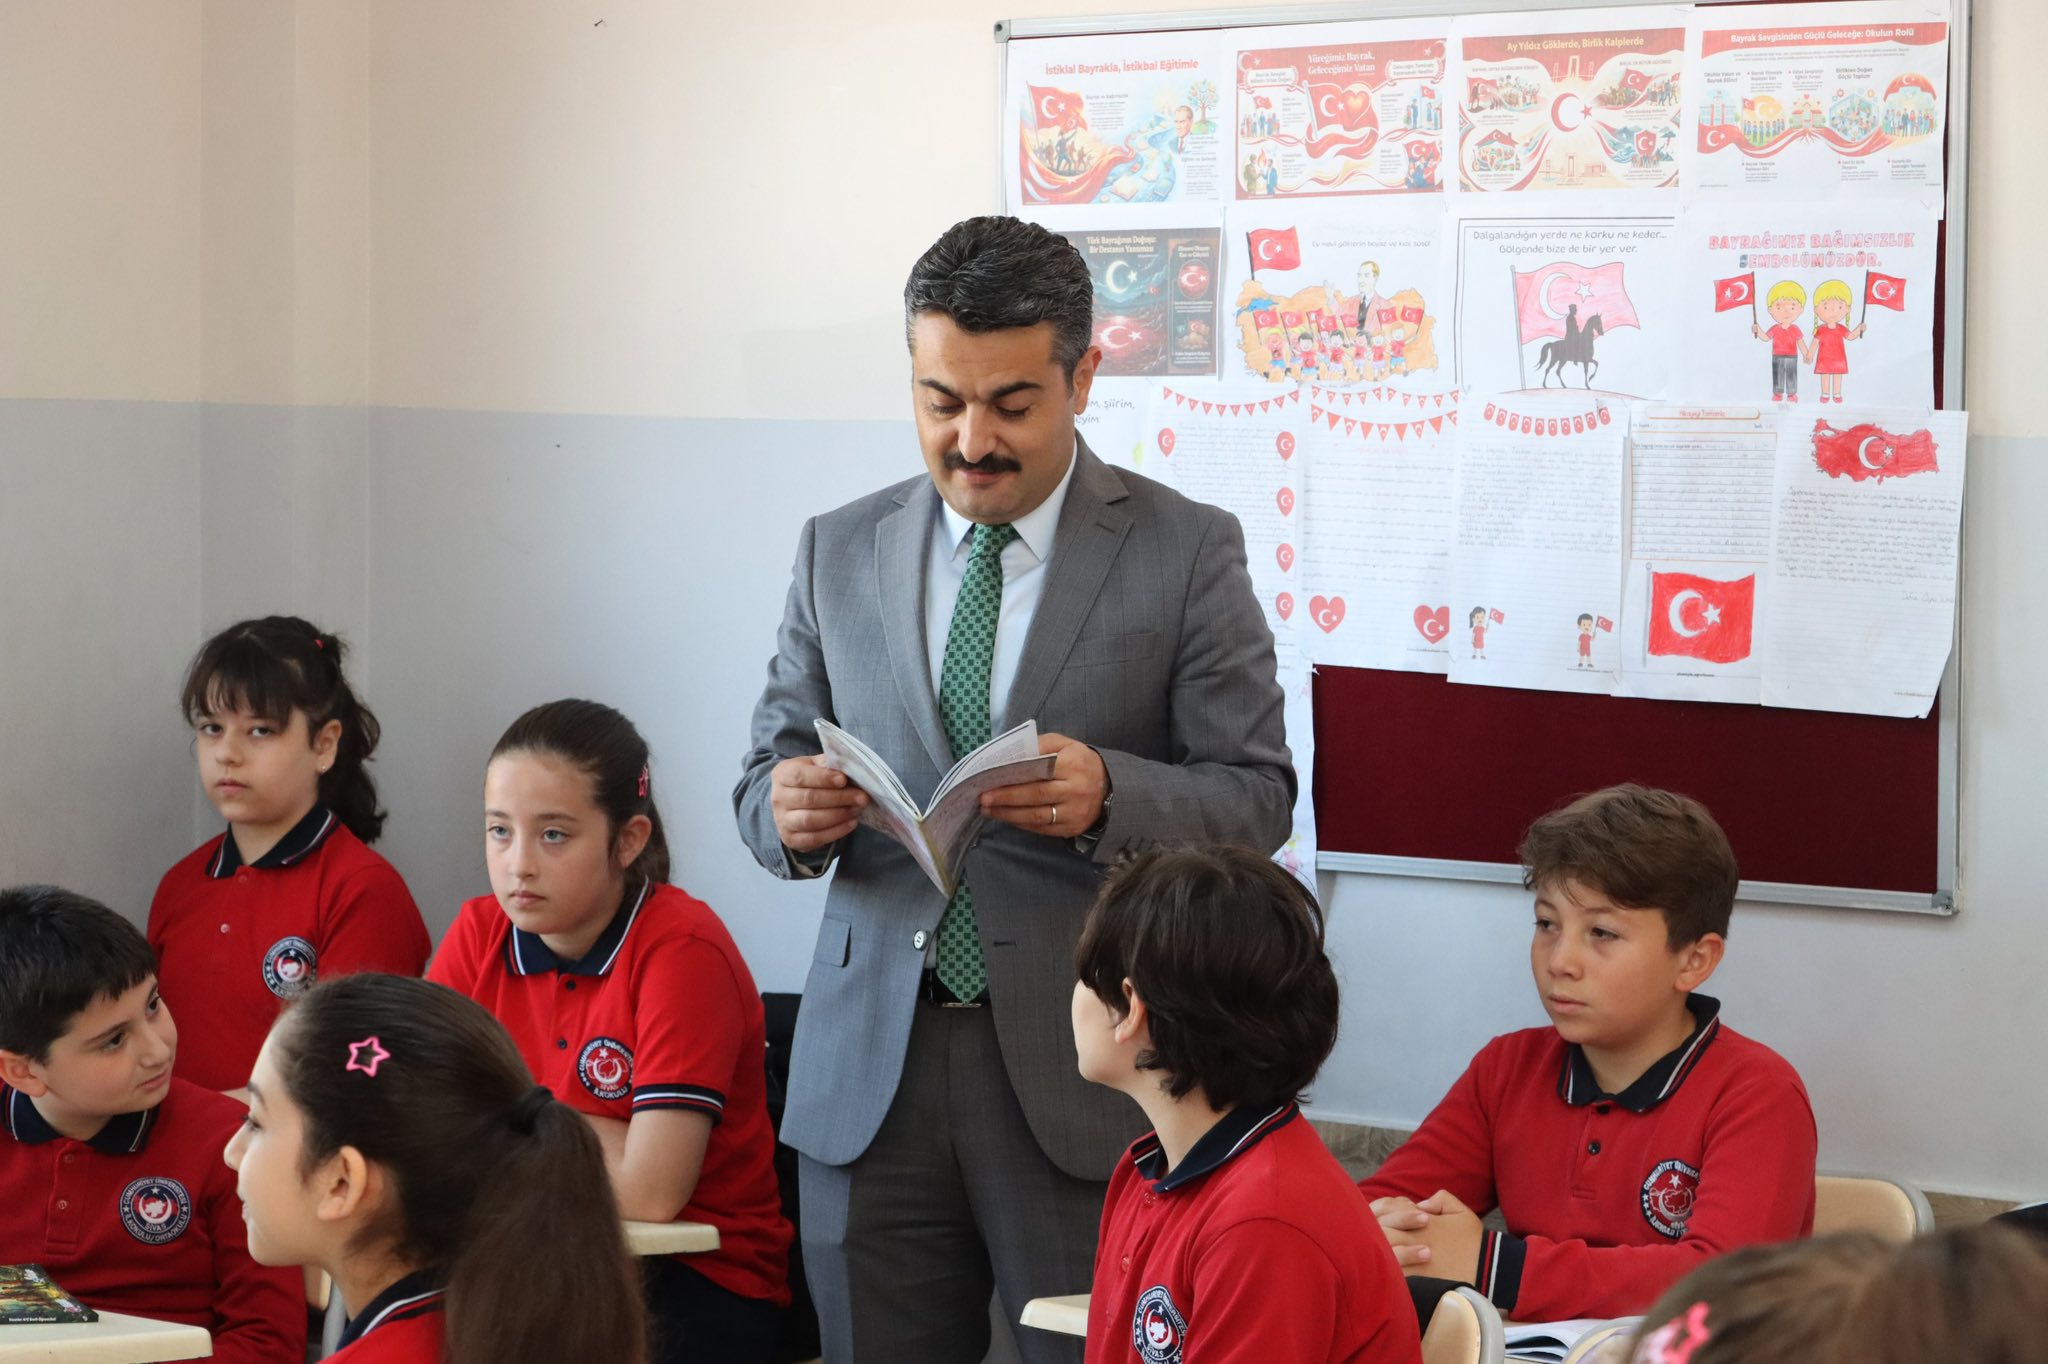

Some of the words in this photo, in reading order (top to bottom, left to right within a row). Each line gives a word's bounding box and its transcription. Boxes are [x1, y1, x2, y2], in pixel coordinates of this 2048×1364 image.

[1731, 34, 1756, 44] Bayrak
[1758, 32, 1802, 42] Sevgisinden
[1804, 30, 1826, 40] Güçlü
[1827, 30, 1863, 40] Geleceğe:
[1865, 29, 1894, 38] Okulun
[1896, 28, 1915, 36] Rolü
[1507, 42, 1517, 52] Ay
[1519, 40, 1541, 50] Yıldız
[1542, 39, 1581, 50] Göklerde,
[1582, 38, 1603, 48] Birlik
[1605, 36, 1644, 48] Kalplerde
[1308, 53, 1346, 65] Yüreğimiz
[1046, 63, 1076, 76] İstiklal
[1078, 63, 1120, 76] Bayrakla,
[1123, 60, 1158, 72] İstikbal
[1160, 59, 1199, 72] Eğitimle
[1308, 64, 1354, 76] Geleceğimiz
[1354, 64, 1376, 72] Vatan
[1473, 231, 1537, 241] Dalgalandığın
[1540, 231, 1567, 241] yerde
[1584, 231, 1614, 239] korku
[1708, 231, 1806, 249] BAYRAĞIMIZ
[1810, 230, 1915, 248] BAĞIMSIZLIK
[1368, 240, 1387, 248] beyaz
[1499, 244, 1543, 255] Gölgende
[1546, 244, 1565, 253] bize
[1568, 244, 1580, 253] de
[1582, 244, 1596, 253] bir
[1599, 246, 1616, 254] yer
[1739, 250, 1882, 269] SEMBOLÜMÜZDÜR.
[1104, 398, 1135, 410] şiirim,
[123, 1178, 154, 1205] CUMHURİYET
[144, 1222, 166, 1232] SİVAS
